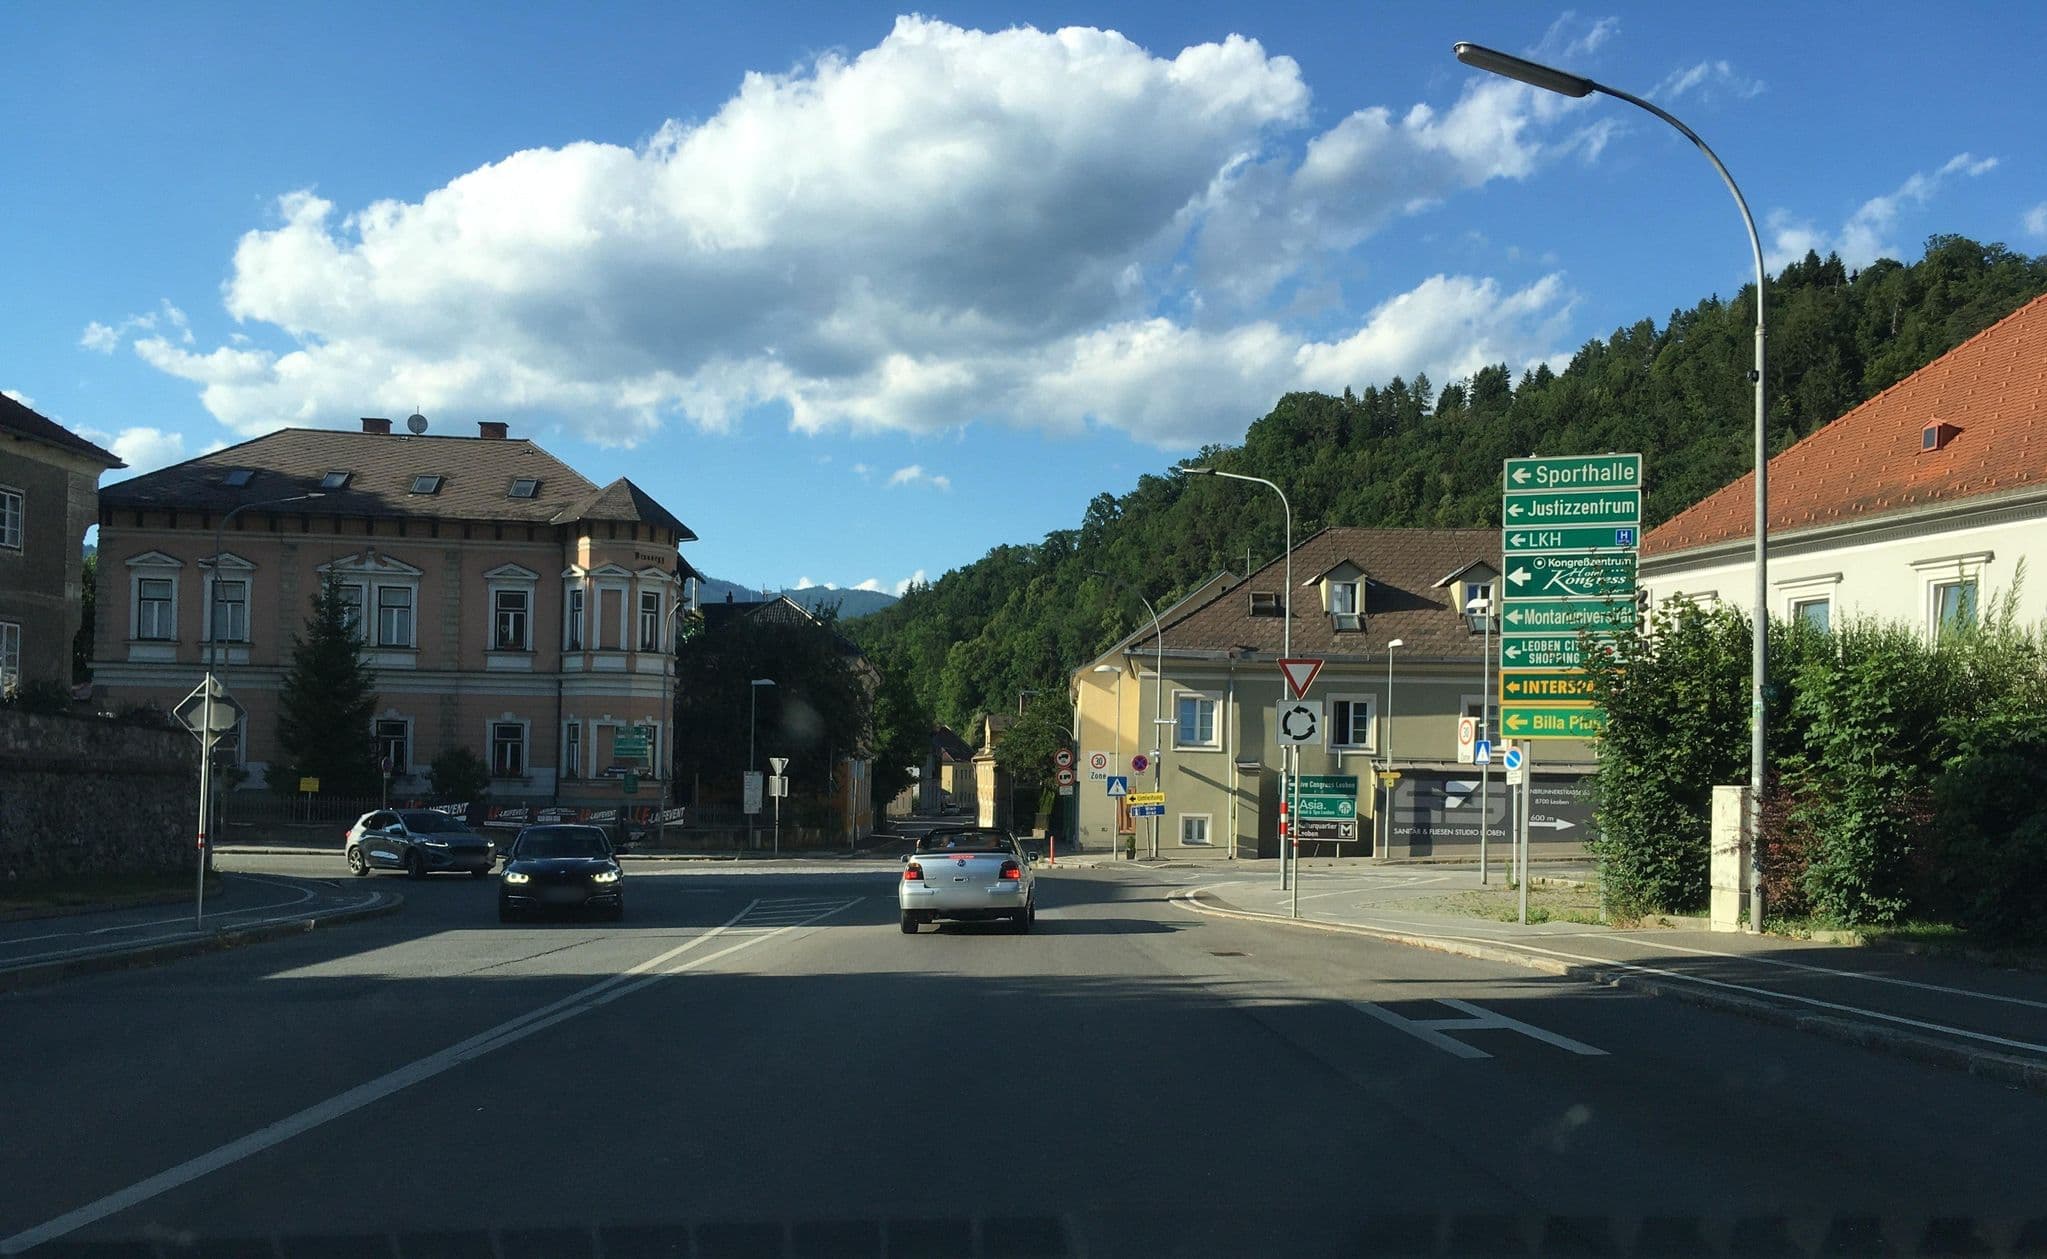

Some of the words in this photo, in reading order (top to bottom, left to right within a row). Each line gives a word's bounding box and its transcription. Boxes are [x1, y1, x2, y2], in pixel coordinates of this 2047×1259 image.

[1536, 462, 1635, 487] Sporthalle
[1527, 499, 1635, 517] Justizzentrum
[1529, 532, 1562, 547] LKH
[1548, 557, 1632, 569] Kongreßzentrum
[1522, 640, 1560, 652] LEOBEN
[1529, 652, 1580, 664] SHOPPING
[1533, 715, 1565, 730] Billa
[1095, 757, 1103, 766] 30
[1091, 772, 1106, 780] Zone
[1530, 814, 1546, 822] 600
[1429, 828, 1454, 836] FLIESEN
[1454, 828, 1480, 837] STUDIO
